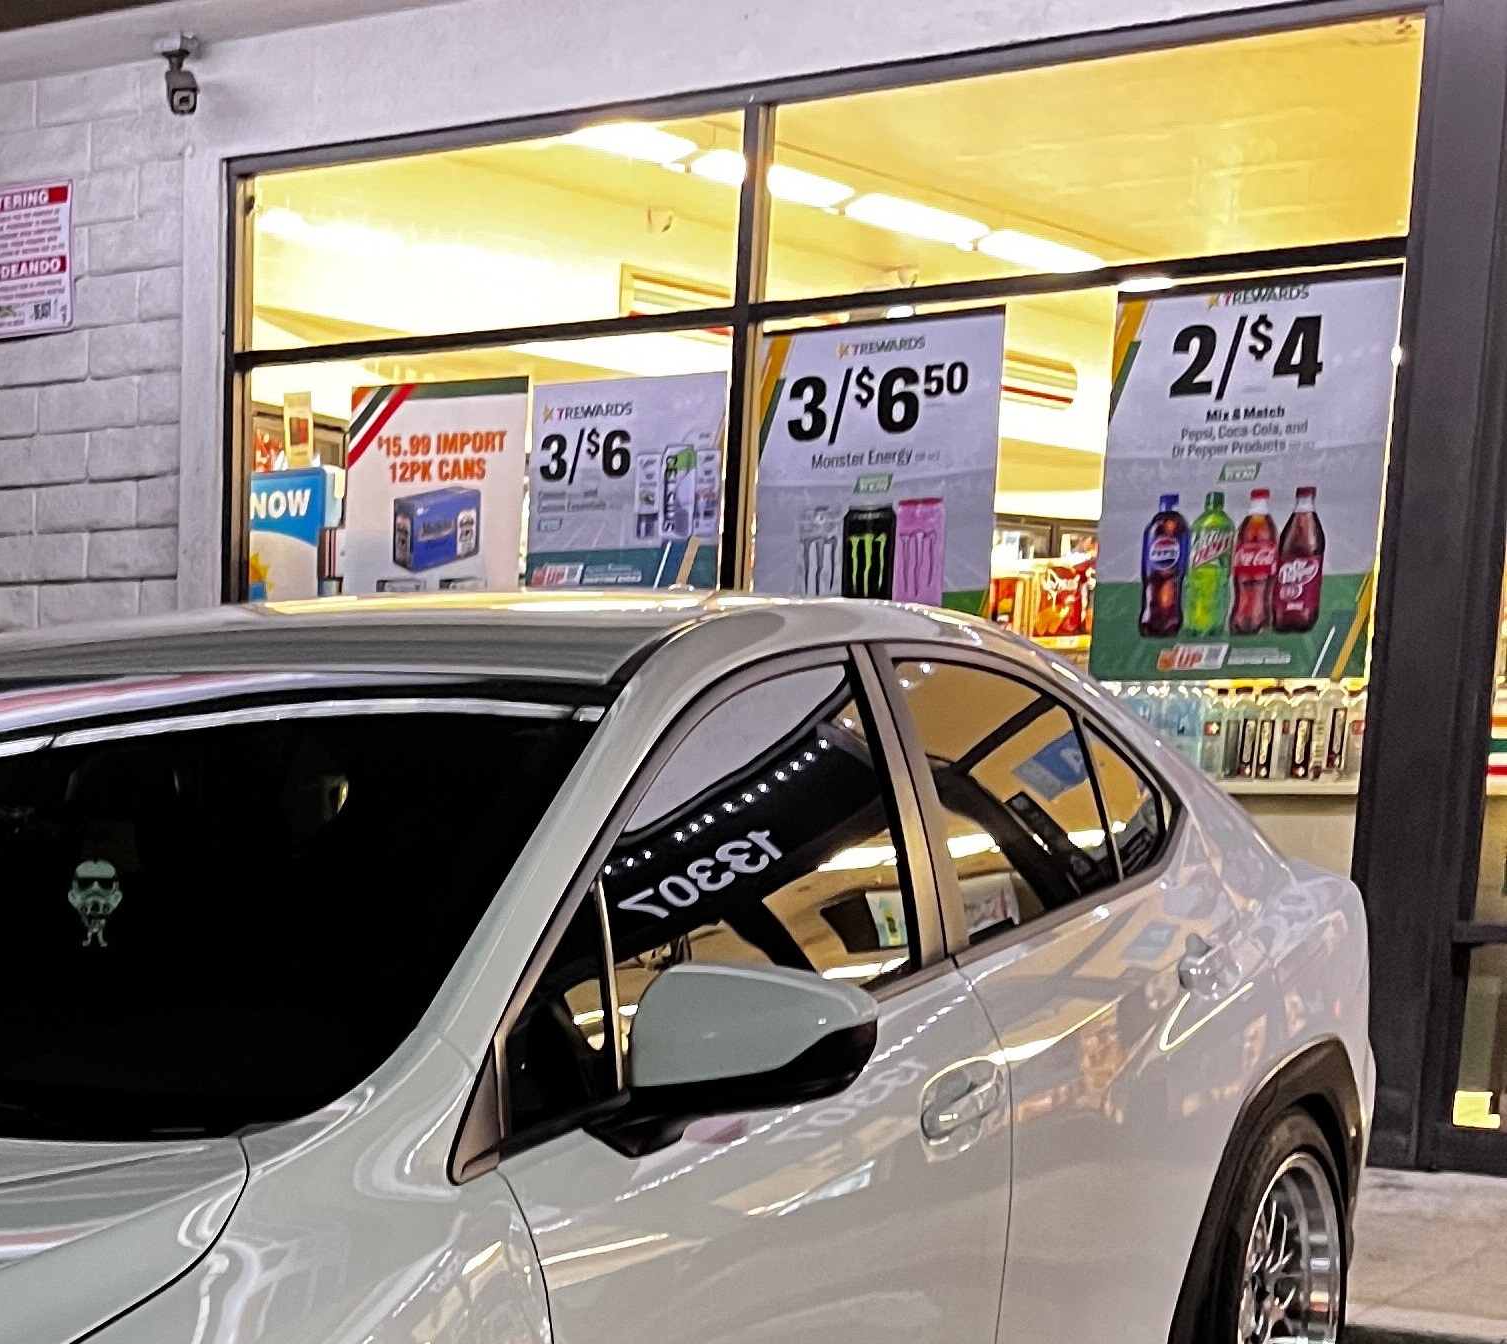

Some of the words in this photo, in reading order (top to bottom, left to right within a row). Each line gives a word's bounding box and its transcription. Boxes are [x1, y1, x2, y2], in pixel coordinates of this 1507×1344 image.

[1206, 408, 1230, 422] Mix
[1243, 405, 1285, 420] Match
[1285, 420, 1308, 433] and
[436, 431, 508, 455] IMPORT
[811, 453, 865, 470] Monster
[868, 448, 913, 466] Energy
[389, 460, 433, 484] 12PK
[439, 459, 486, 483] CANS
